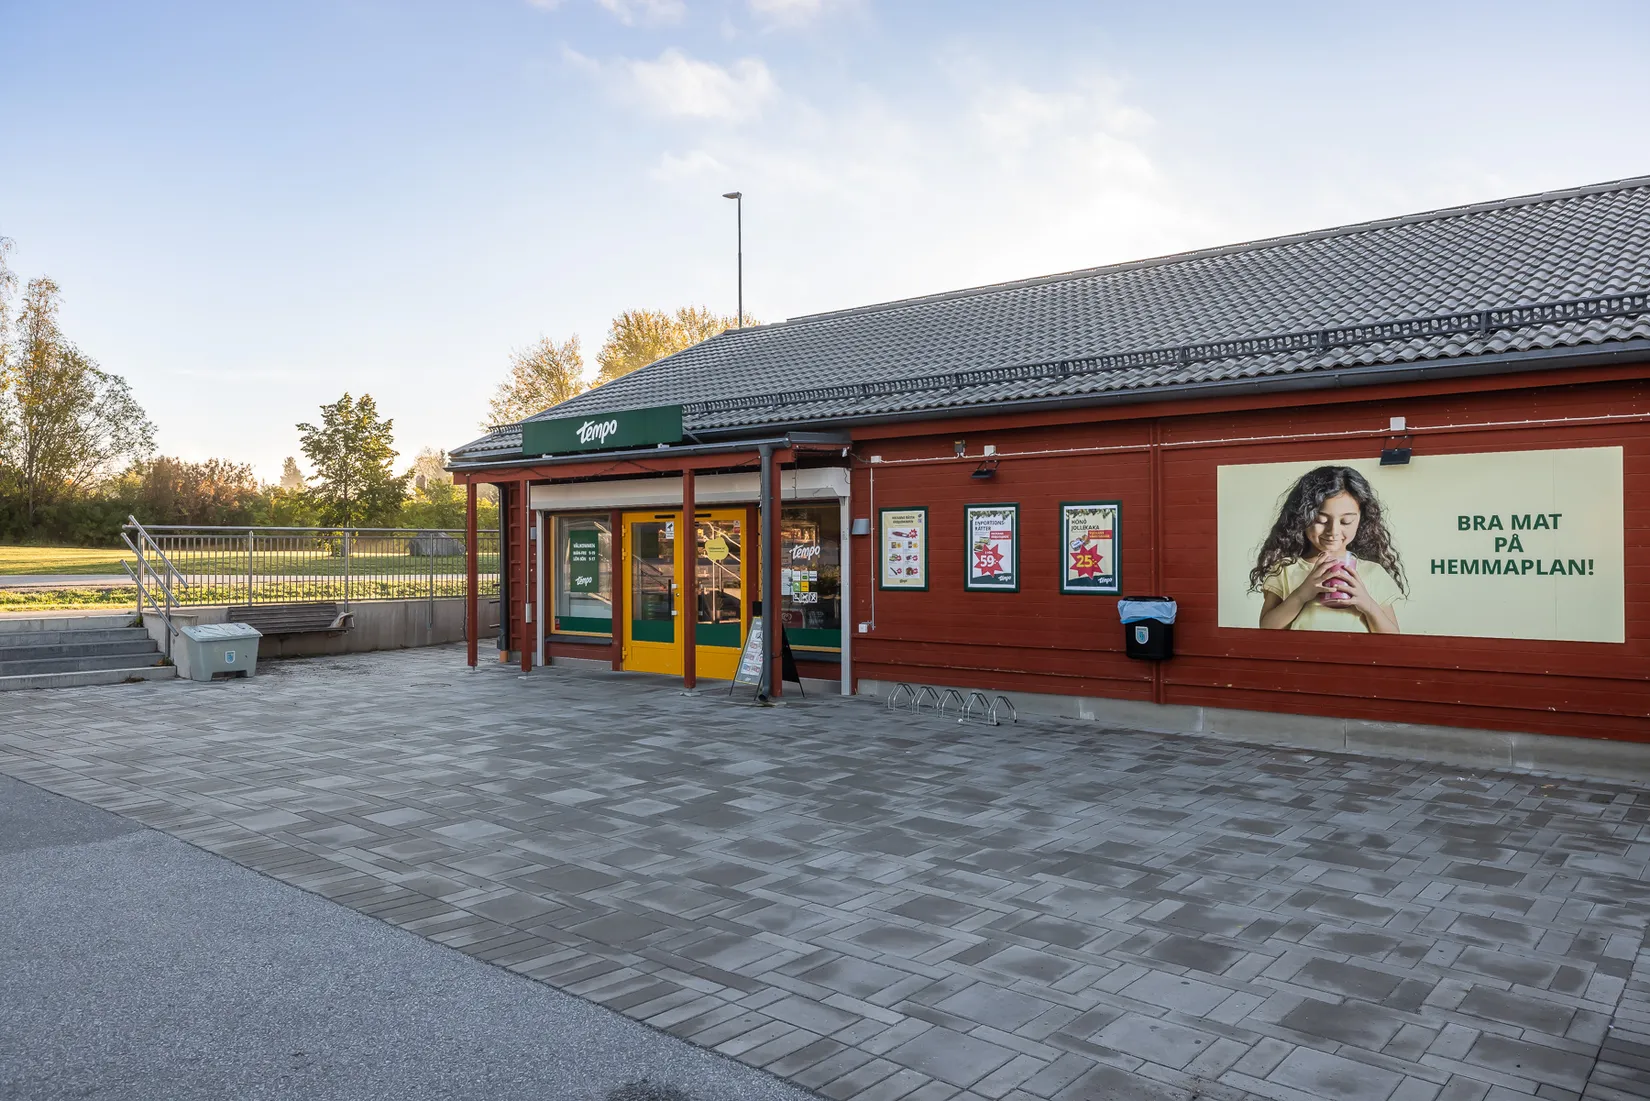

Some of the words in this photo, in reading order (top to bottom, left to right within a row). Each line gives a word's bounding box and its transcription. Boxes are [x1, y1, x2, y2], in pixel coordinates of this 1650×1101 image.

[1457, 514, 1504, 531] BRA
[1511, 513, 1563, 530] MAT
[1494, 533, 1524, 553] PÅ
[1430, 558, 1594, 576] HEMMAPLAN!
